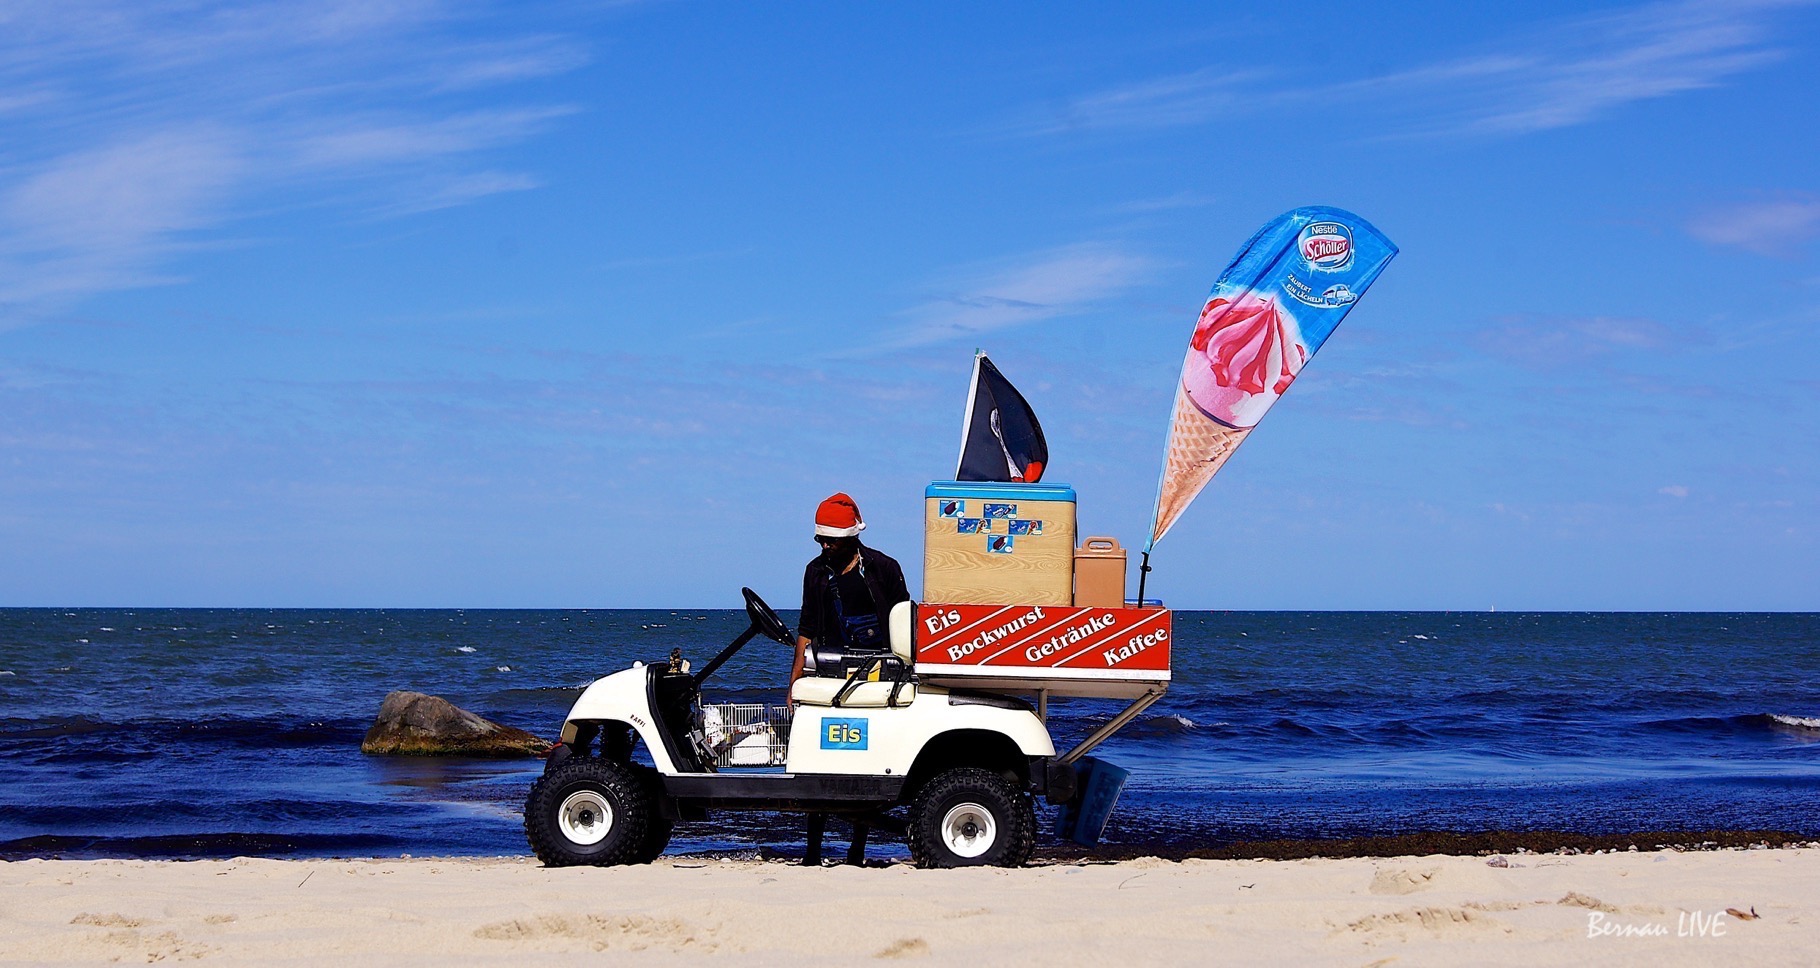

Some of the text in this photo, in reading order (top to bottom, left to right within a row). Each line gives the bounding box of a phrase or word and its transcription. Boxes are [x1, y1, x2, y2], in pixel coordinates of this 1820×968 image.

[1306, 240, 1347, 260] Schöller
[1286, 284, 1323, 303] EIN LÄCHELN
[1287, 274, 1312, 293] ZAUBERT
[924, 609, 962, 635] Eis
[946, 605, 1046, 662] Bockwurst
[1025, 611, 1116, 662] Getränke
[1102, 627, 1168, 667] Kaffee
[828, 723, 862, 743] Eis
